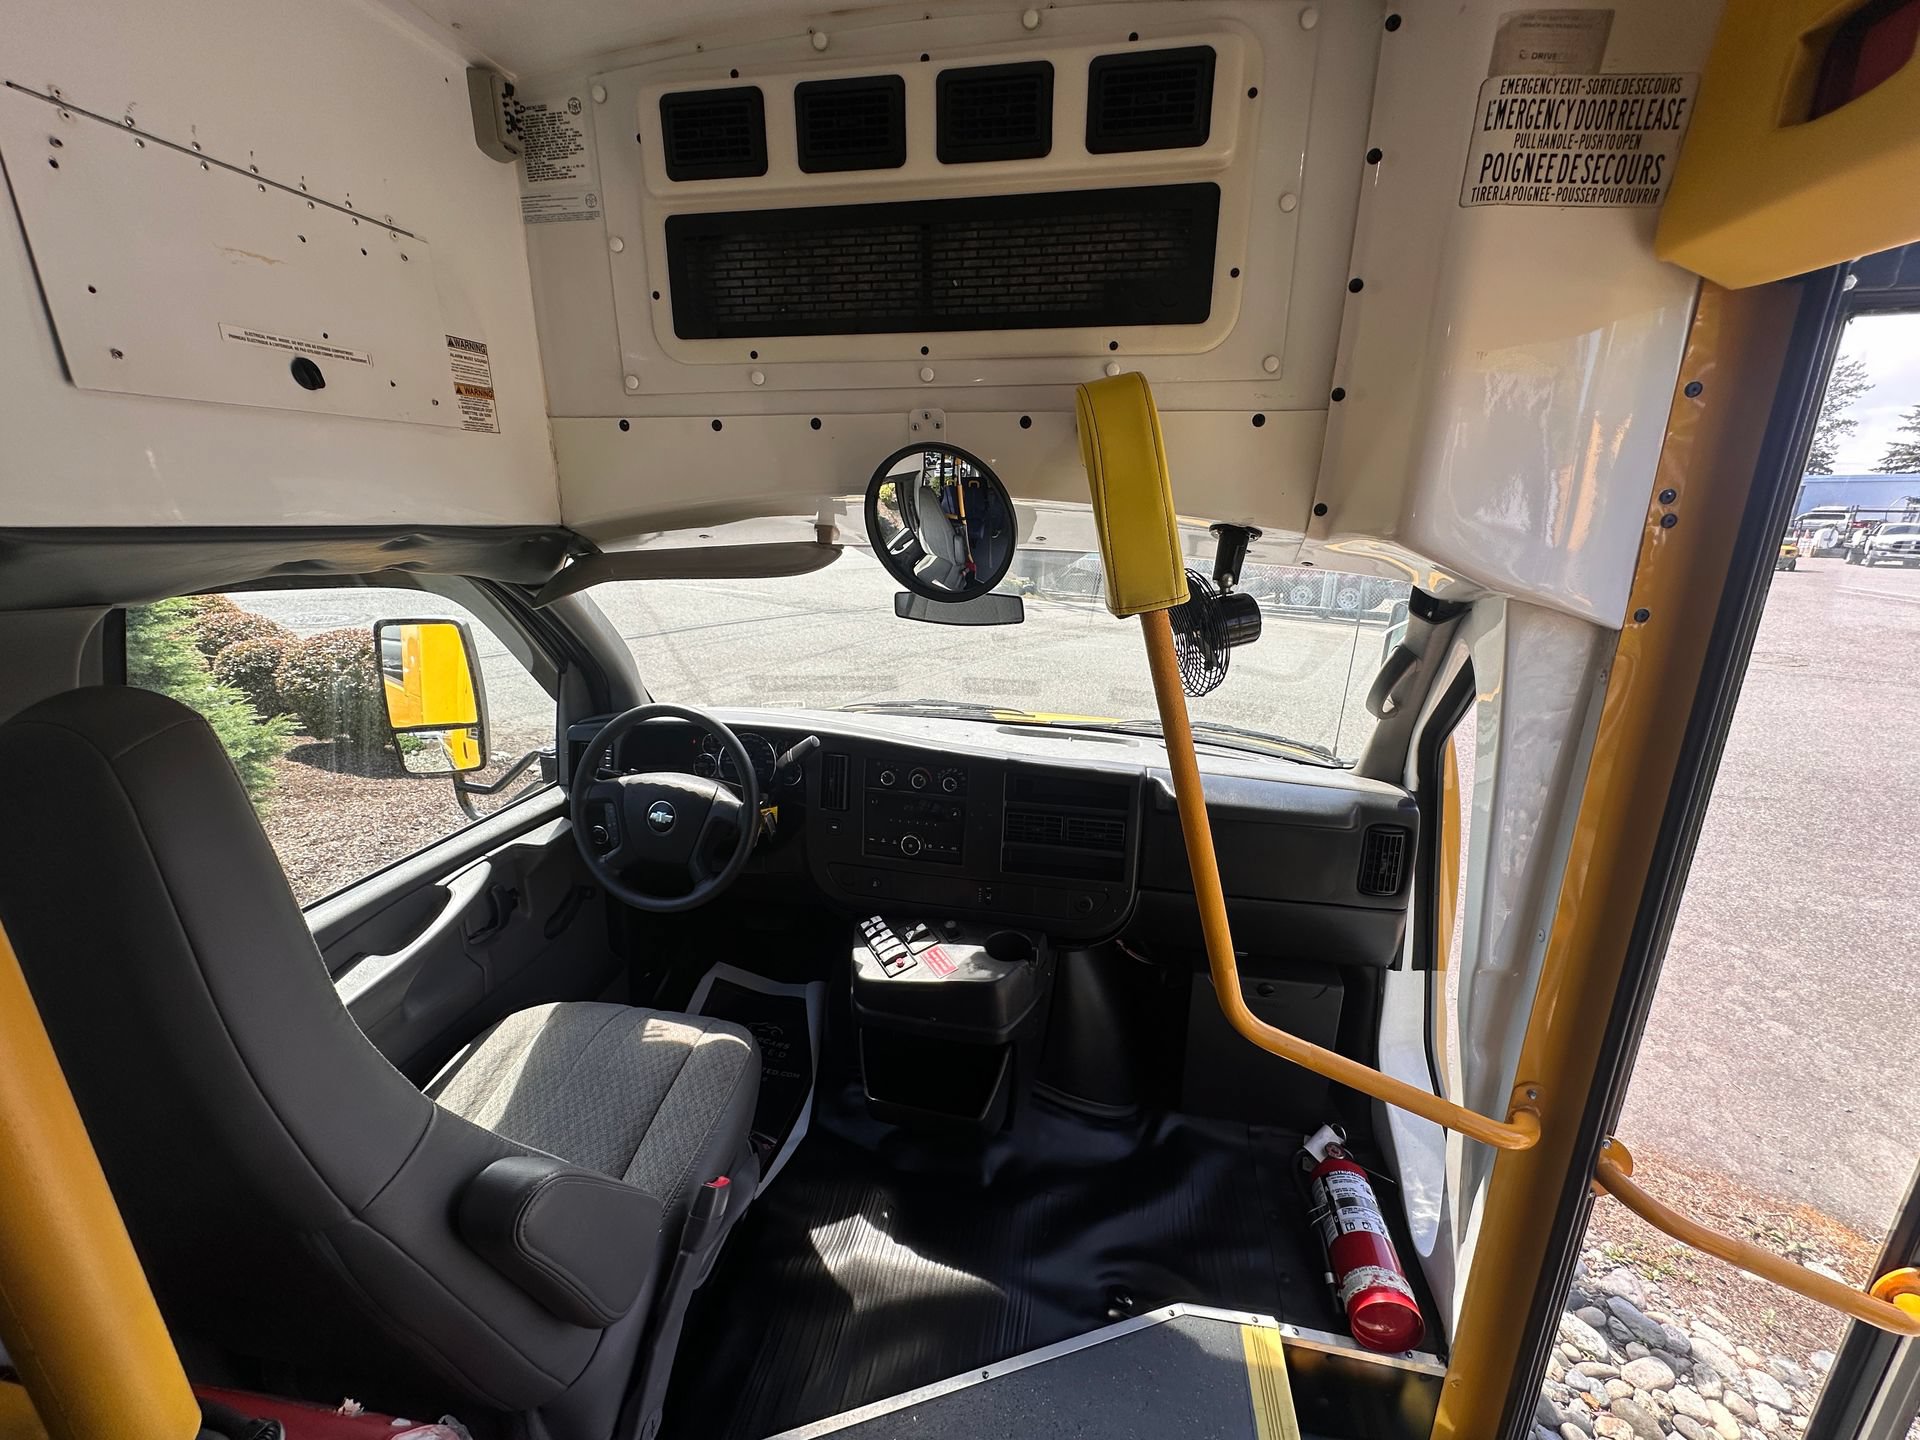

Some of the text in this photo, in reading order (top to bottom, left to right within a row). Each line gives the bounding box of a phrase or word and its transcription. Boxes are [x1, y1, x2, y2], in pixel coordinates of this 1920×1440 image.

[1500, 78, 1561, 95] EMERGENCY
[1560, 78, 1582, 94] EXIT
[1586, 78, 1621, 95] SORTIE
[1621, 78, 1635, 94] DE
[1634, 77, 1683, 94] SECOURS
[1484, 97, 1687, 131] EMERGENCY DOOR RELEASE
[1513, 132, 1537, 149] PULL
[1537, 133, 1575, 149] HANDLE
[1578, 134, 1605, 150] PUSH
[1604, 134, 1617, 150] TO
[1615, 134, 1642, 150] OPEN
[1479, 152, 1665, 185] POIGNEE DE SECOURS
[1472, 186, 1500, 202] TIRER
[1499, 186, 1511, 201] LA
[1511, 186, 1552, 202] POIGNEE
[1556, 187, 1598, 202] POUSSER
[1597, 187, 1623, 203] POUR
[1622, 188, 1660, 203] OUVRIR
[454, 338, 486, 353] WARNING
[464, 387, 493, 399] WARNING
